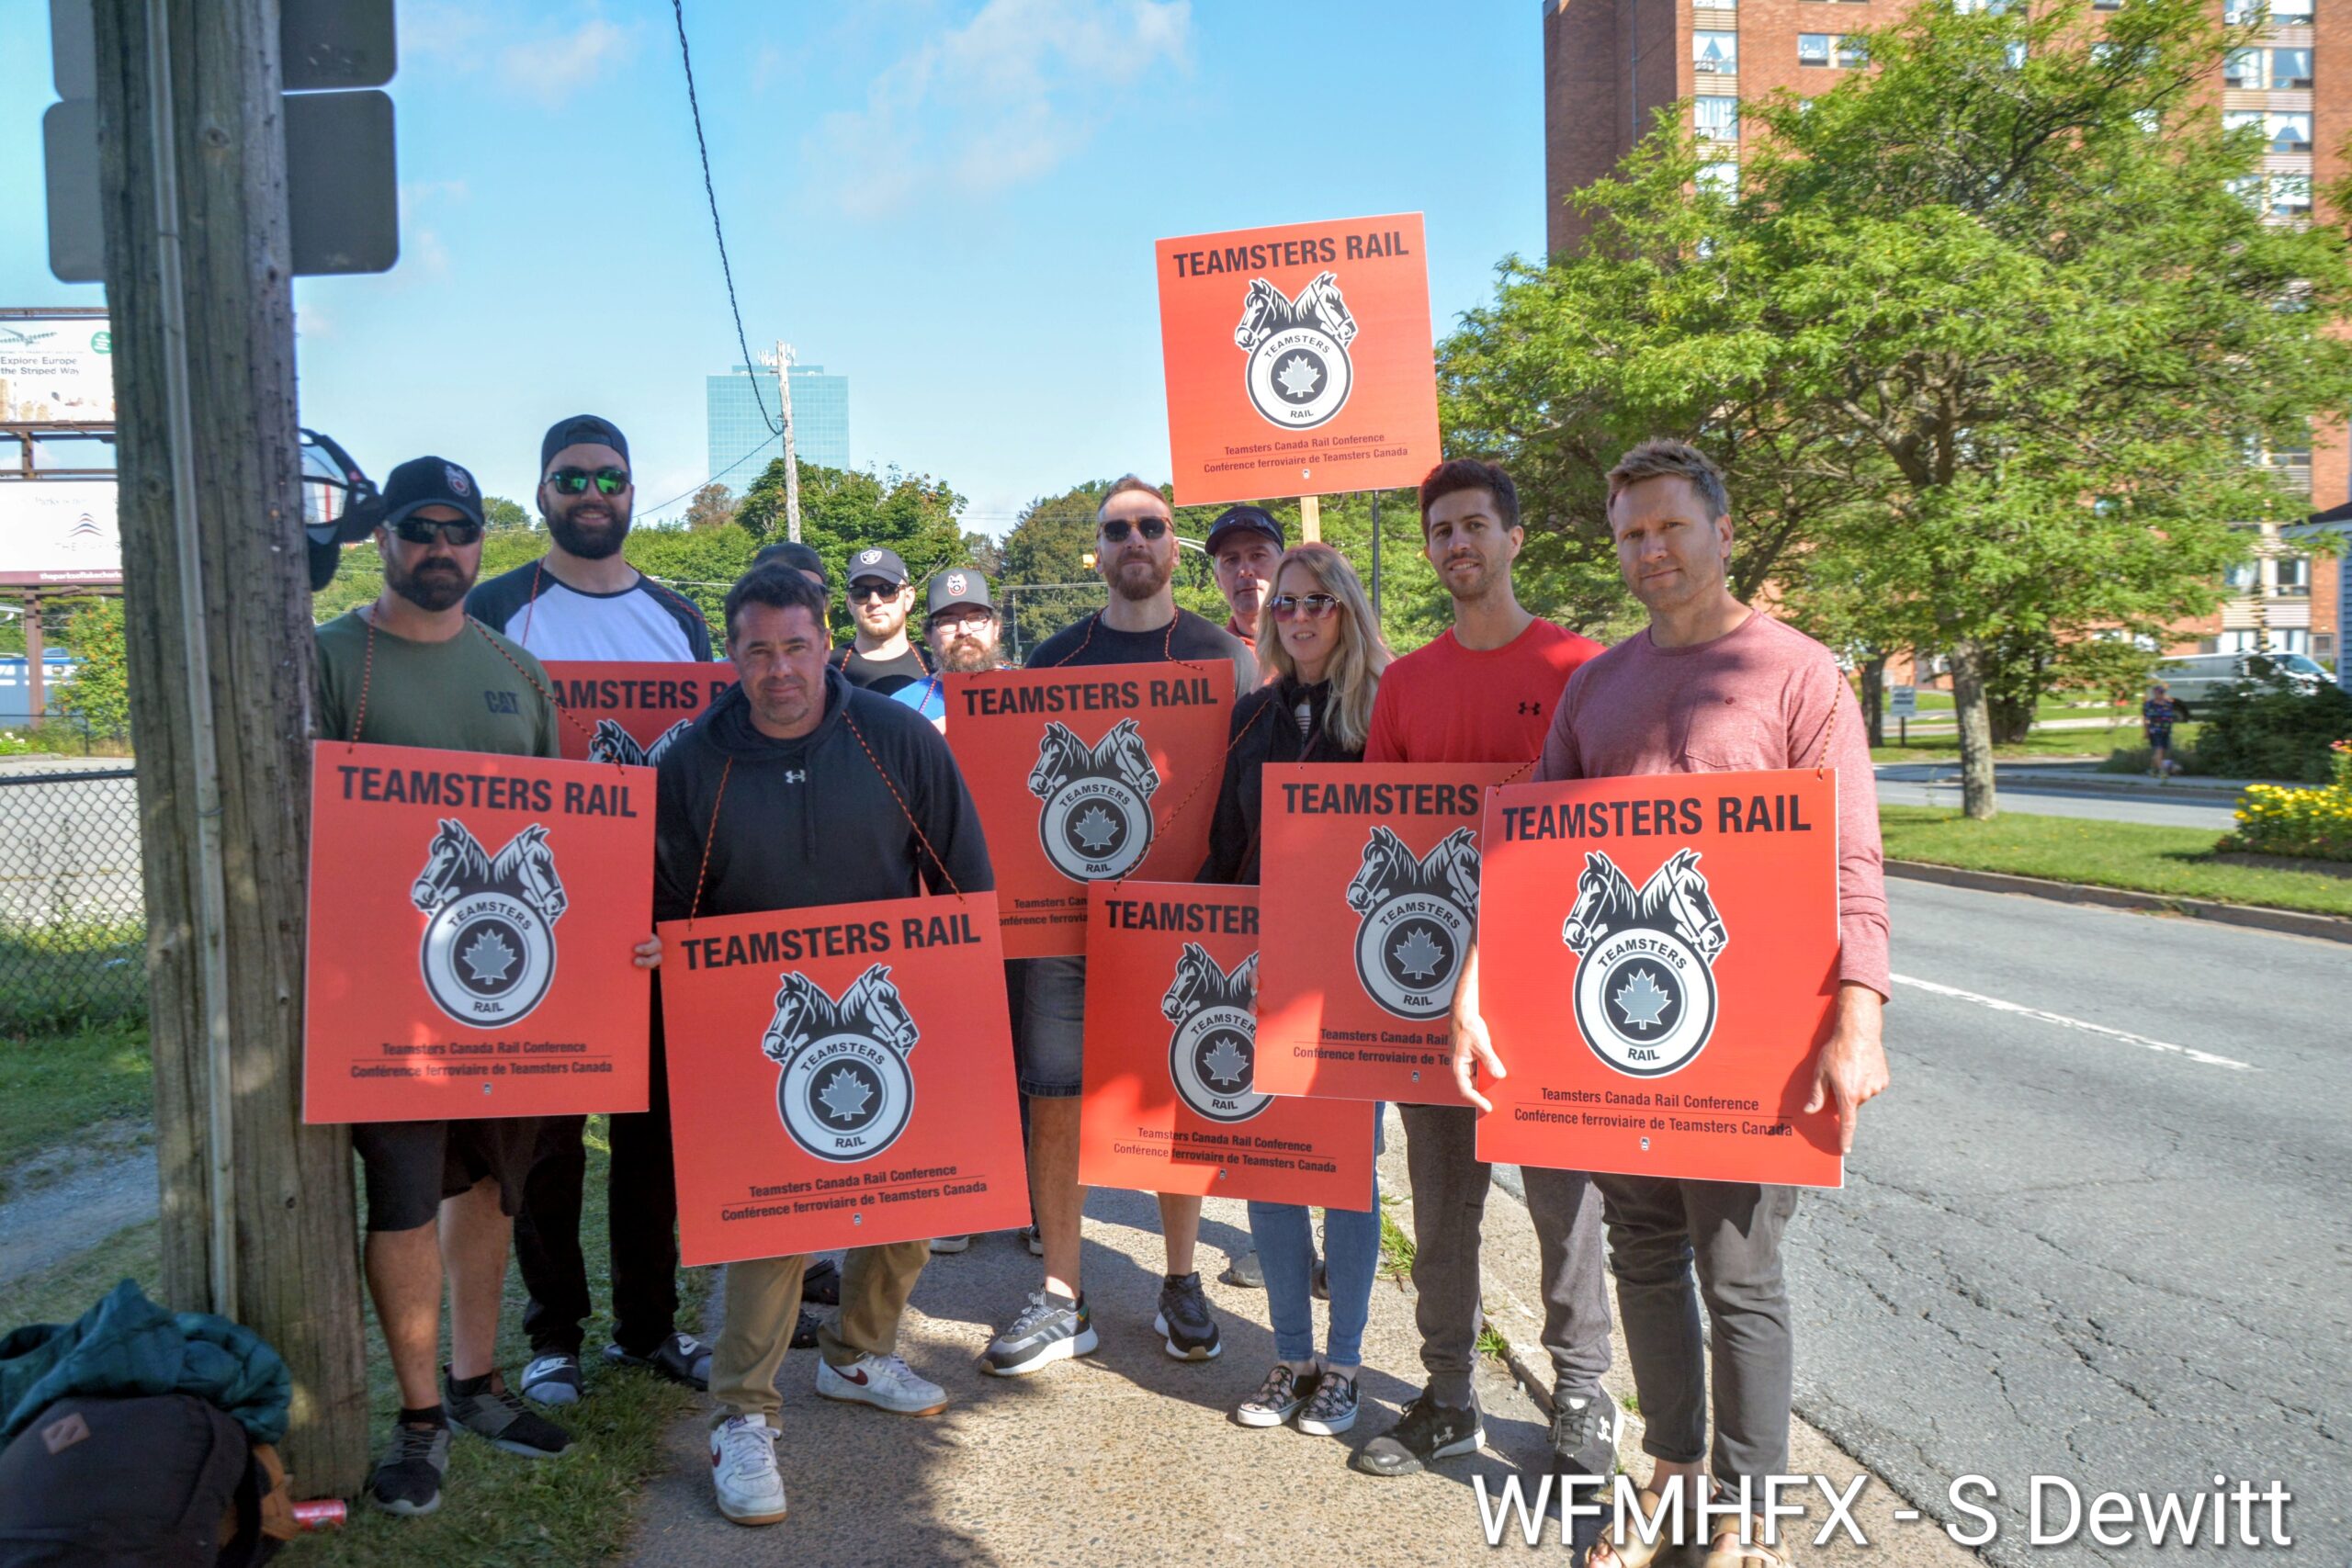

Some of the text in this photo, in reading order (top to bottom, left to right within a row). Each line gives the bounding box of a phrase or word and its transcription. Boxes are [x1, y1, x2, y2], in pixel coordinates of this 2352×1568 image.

[1173, 231, 1409, 278] TEAMSTERS RAIL
[1264, 334, 1330, 359] TEAMSTERS
[1, 356, 78, 366] Explore Europe
[1, 367, 17, 375] the
[20, 367, 56, 376] Striped
[1289, 409, 1314, 419] RAIL
[1225, 433, 1385, 456] Teamsters Canada Rail Conference
[1204, 447, 1408, 473] Conférence ferroviaire de Teamsters Canada
[484, 691, 520, 714] CAT
[552, 680, 698, 709] AMSTERS
[961, 677, 1218, 716] TEAMSTERS RAIL
[337, 765, 637, 818] TEAMSTERS RAIL
[1058, 784, 1131, 808] TEAMSTERS
[1282, 783, 1479, 816] TEAMSTERS
[1502, 794, 1812, 842] TEAMSTERS RAIL
[1085, 863, 1112, 873] RAIL
[1014, 897, 1088, 909] Teamsters Can
[1379, 900, 1461, 930] TEAMSTERS
[447, 900, 532, 931] TEAMSTERS
[1050, 914, 1088, 925] ferrovia
[1105, 899, 1260, 935] TEAMSTER
[681, 913, 981, 971] TEAMSTERS RAIL
[1597, 938, 1688, 971] TEAMSTERS
[472, 1000, 504, 1013] RAIL
[1403, 994, 1433, 1007] RAIL
[1191, 1013, 1256, 1035] TEAMSTER
[382, 1040, 586, 1055] Teamsters Canada Rail Conference
[1320, 1028, 1448, 1045] Teamsters Canada Rail
[800, 1042, 885, 1072] TEAMSTERS
[1293, 1045, 1355, 1061] Conférence
[1358, 1049, 1417, 1065] ferroviaire
[1420, 1053, 1434, 1066] de
[1627, 1046, 1661, 1062] RAIL
[351, 1061, 613, 1078] Conférence ferroviaire de Teamsters Canada
[1212, 1099, 1238, 1111] RAIL
[1541, 1087, 1758, 1111] Teamsters Canada Rail Conference
[1514, 1107, 1792, 1136] Conférence ferroviaire de Teamsters Canada
[834, 1135, 866, 1148] RAIL
[1137, 1127, 1312, 1153] Teamsters Canada Rail Conference
[1114, 1143, 1337, 1173] Conférence ferroviaire de Teamsters Canada
[749, 1164, 957, 1198] Teamsters Canada Rail Conference
[721, 1181, 987, 1222] Conférence ferroviaire de Teamsters Canada
